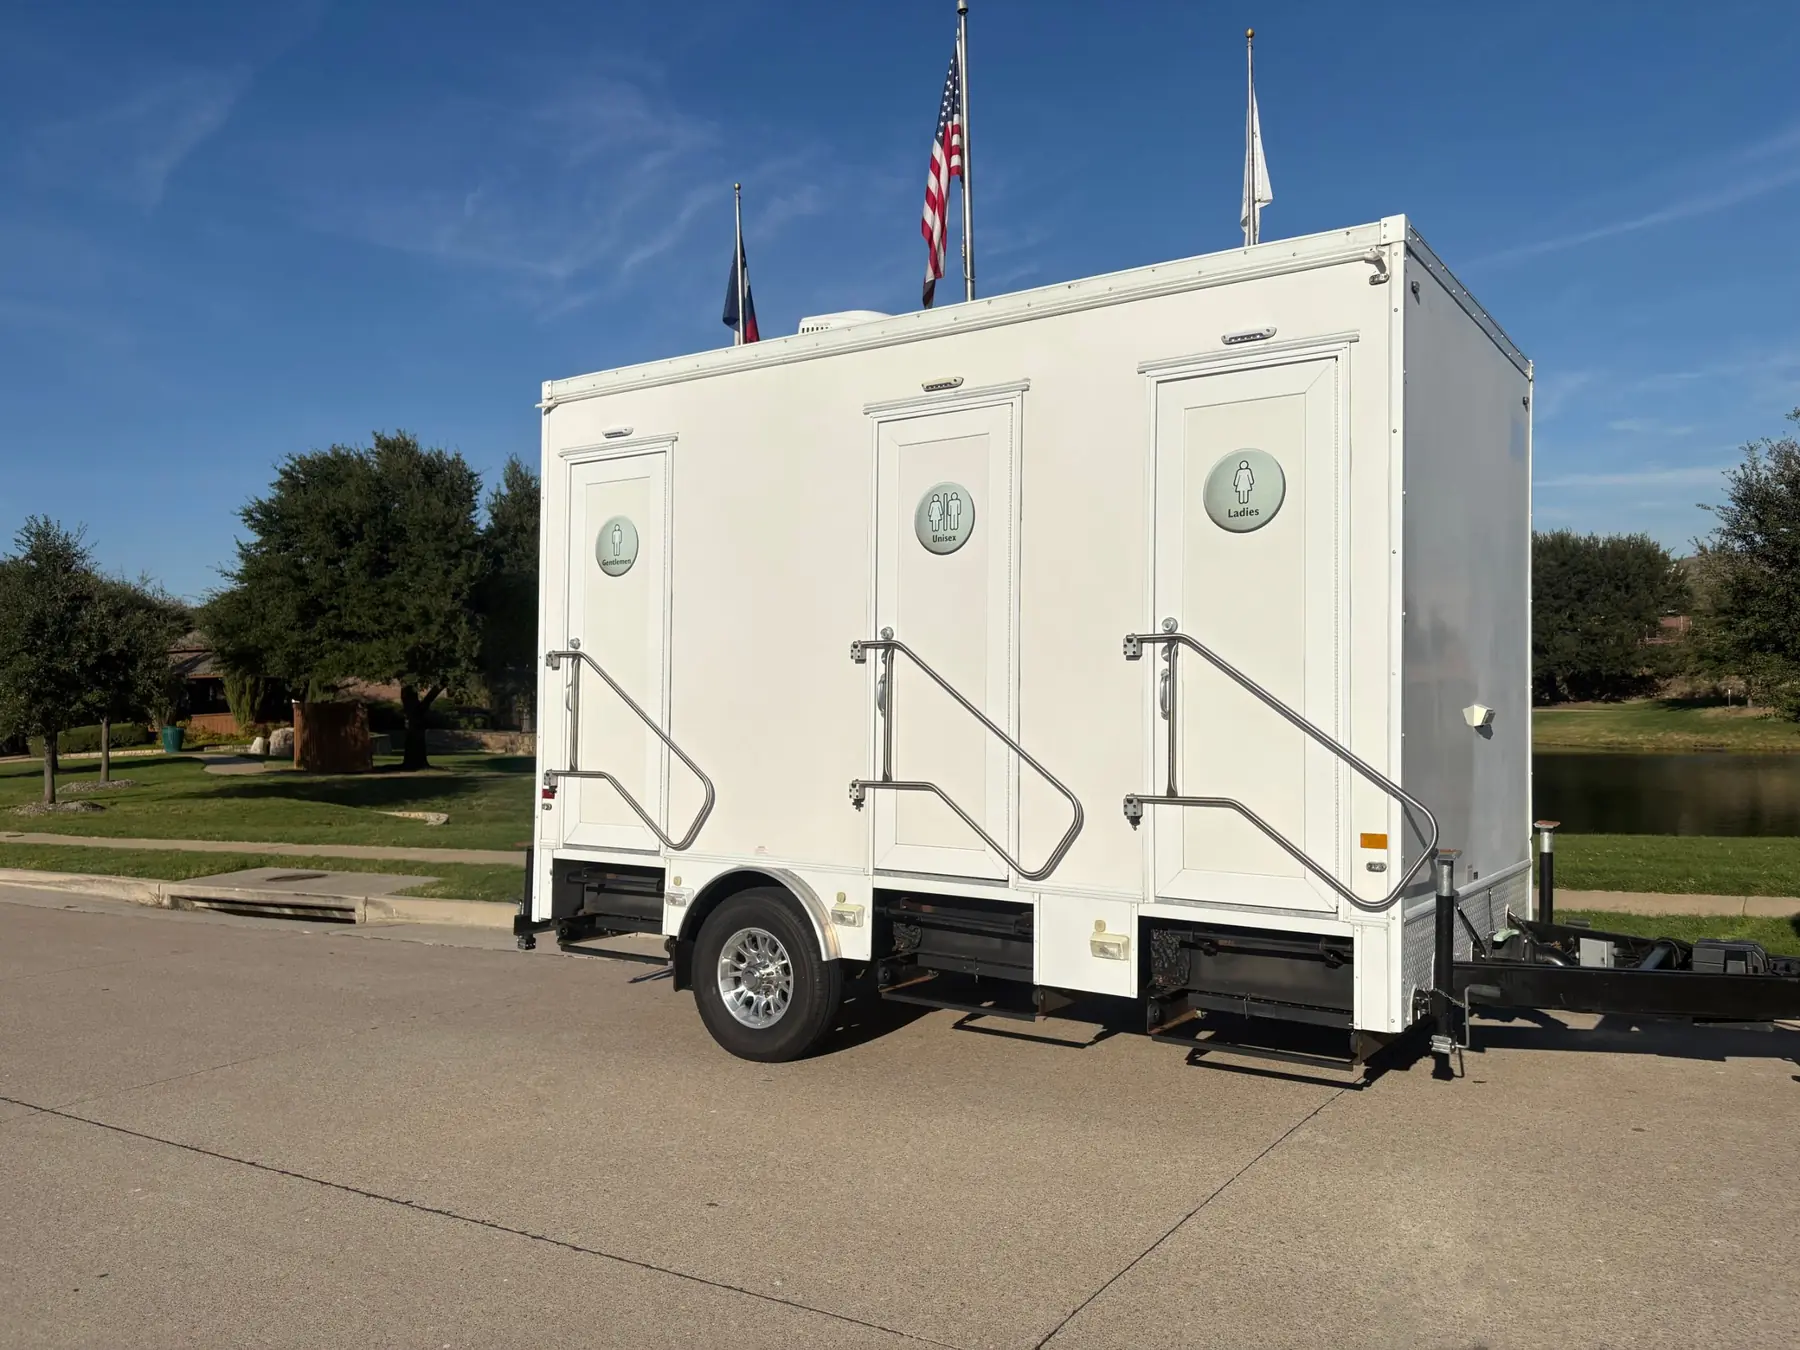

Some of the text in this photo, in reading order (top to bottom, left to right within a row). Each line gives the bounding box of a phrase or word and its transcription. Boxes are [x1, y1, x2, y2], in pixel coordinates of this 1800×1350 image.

[1228, 507, 1260, 518] Ladies
[932, 534, 957, 543] Unisex
[601, 558, 632, 566] Gentlemen
